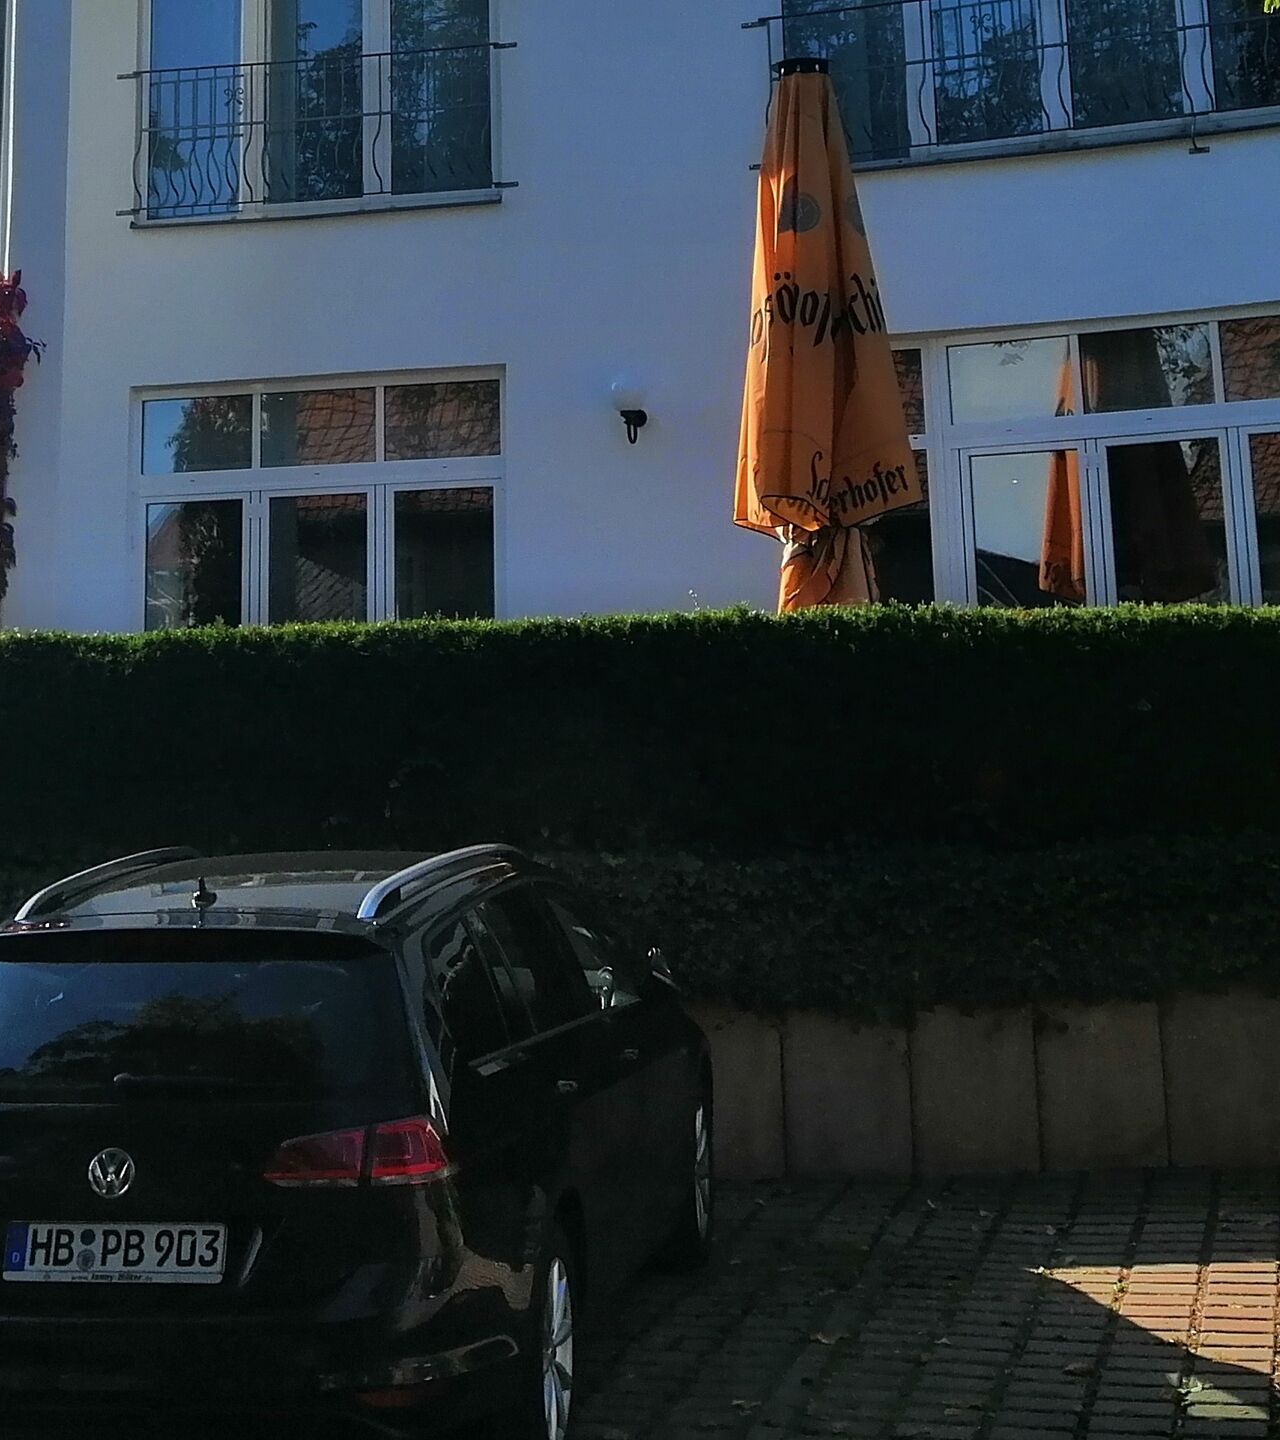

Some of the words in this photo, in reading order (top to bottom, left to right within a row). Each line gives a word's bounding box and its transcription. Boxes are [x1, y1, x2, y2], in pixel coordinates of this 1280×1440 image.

[28, 1228, 75, 1267] HB
[100, 1229, 146, 1267] PB
[154, 1229, 221, 1268] 903
